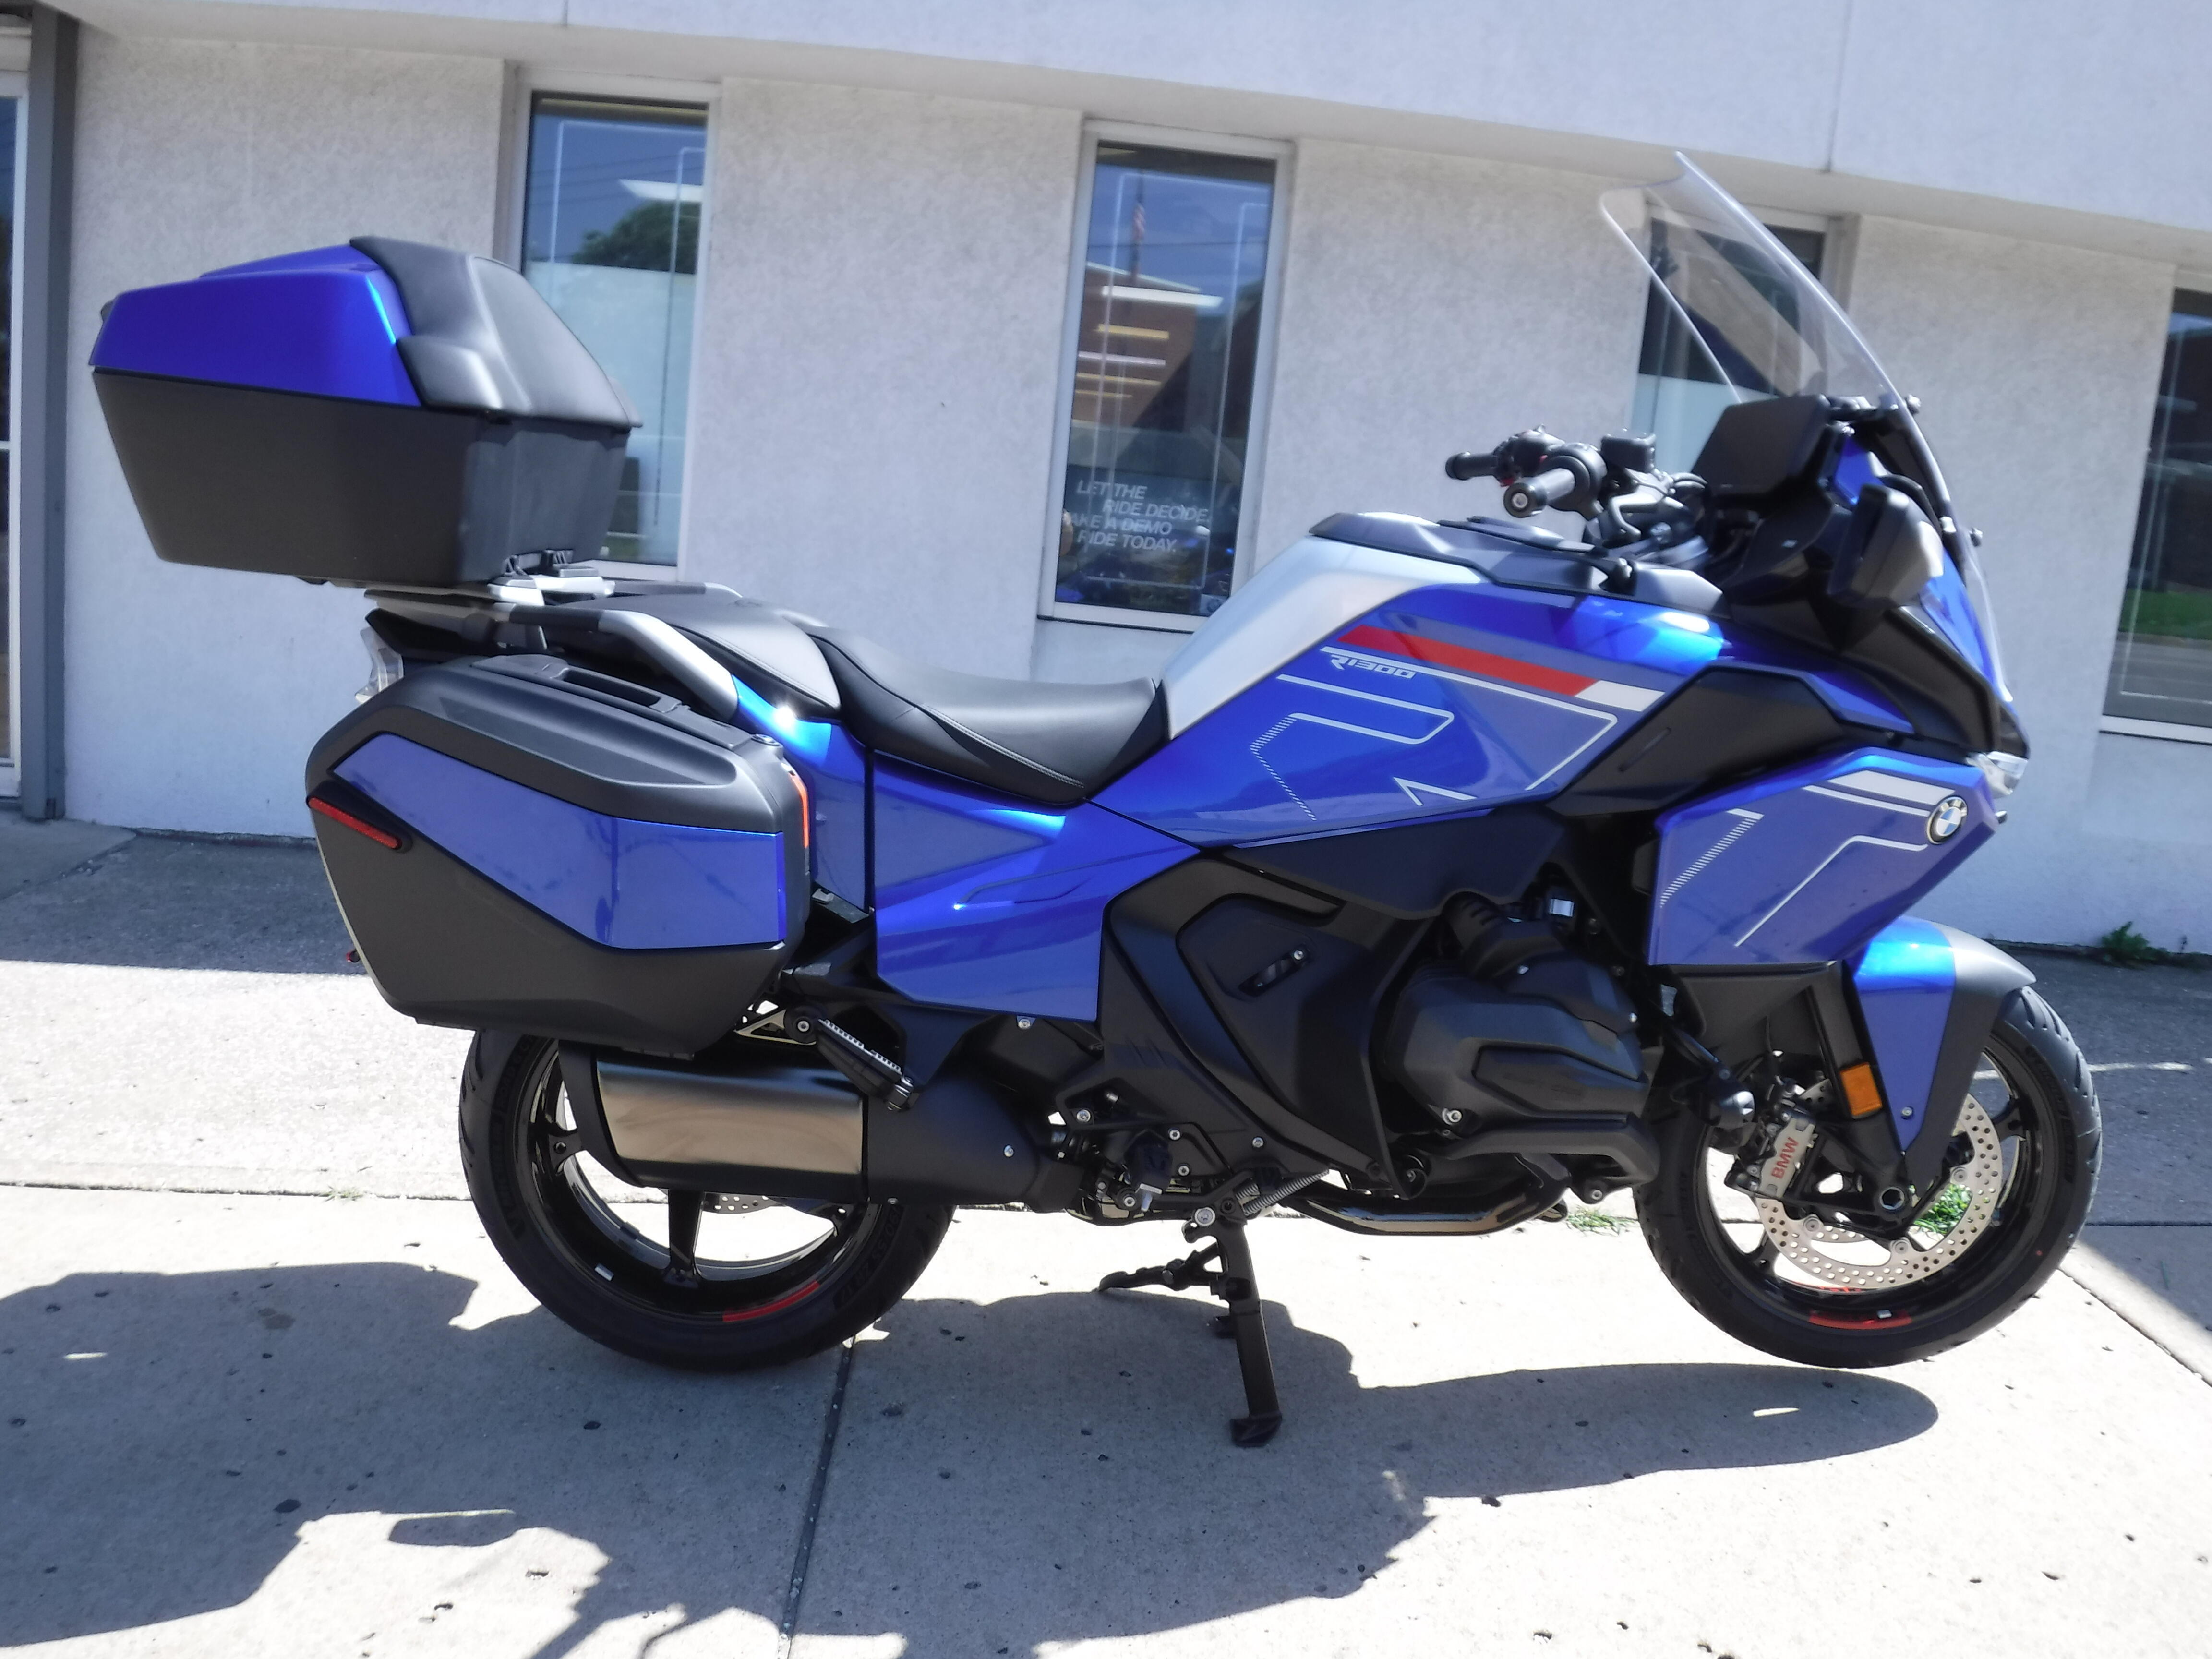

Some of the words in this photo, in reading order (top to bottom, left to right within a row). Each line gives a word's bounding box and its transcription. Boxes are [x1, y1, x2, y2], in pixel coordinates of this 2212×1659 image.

[1077, 480, 1110, 495] LET
[1115, 483, 1147, 499] THE
[1103, 500, 1143, 516] RIDE
[1105, 515, 1117, 529] A
[1121, 517, 1172, 535] DEMO
[1078, 530, 1118, 546] RIDE
[1123, 534, 1177, 552] TODAY.
[1331, 654, 1417, 679] R1300
[1772, 1137, 1798, 1178] BMW
